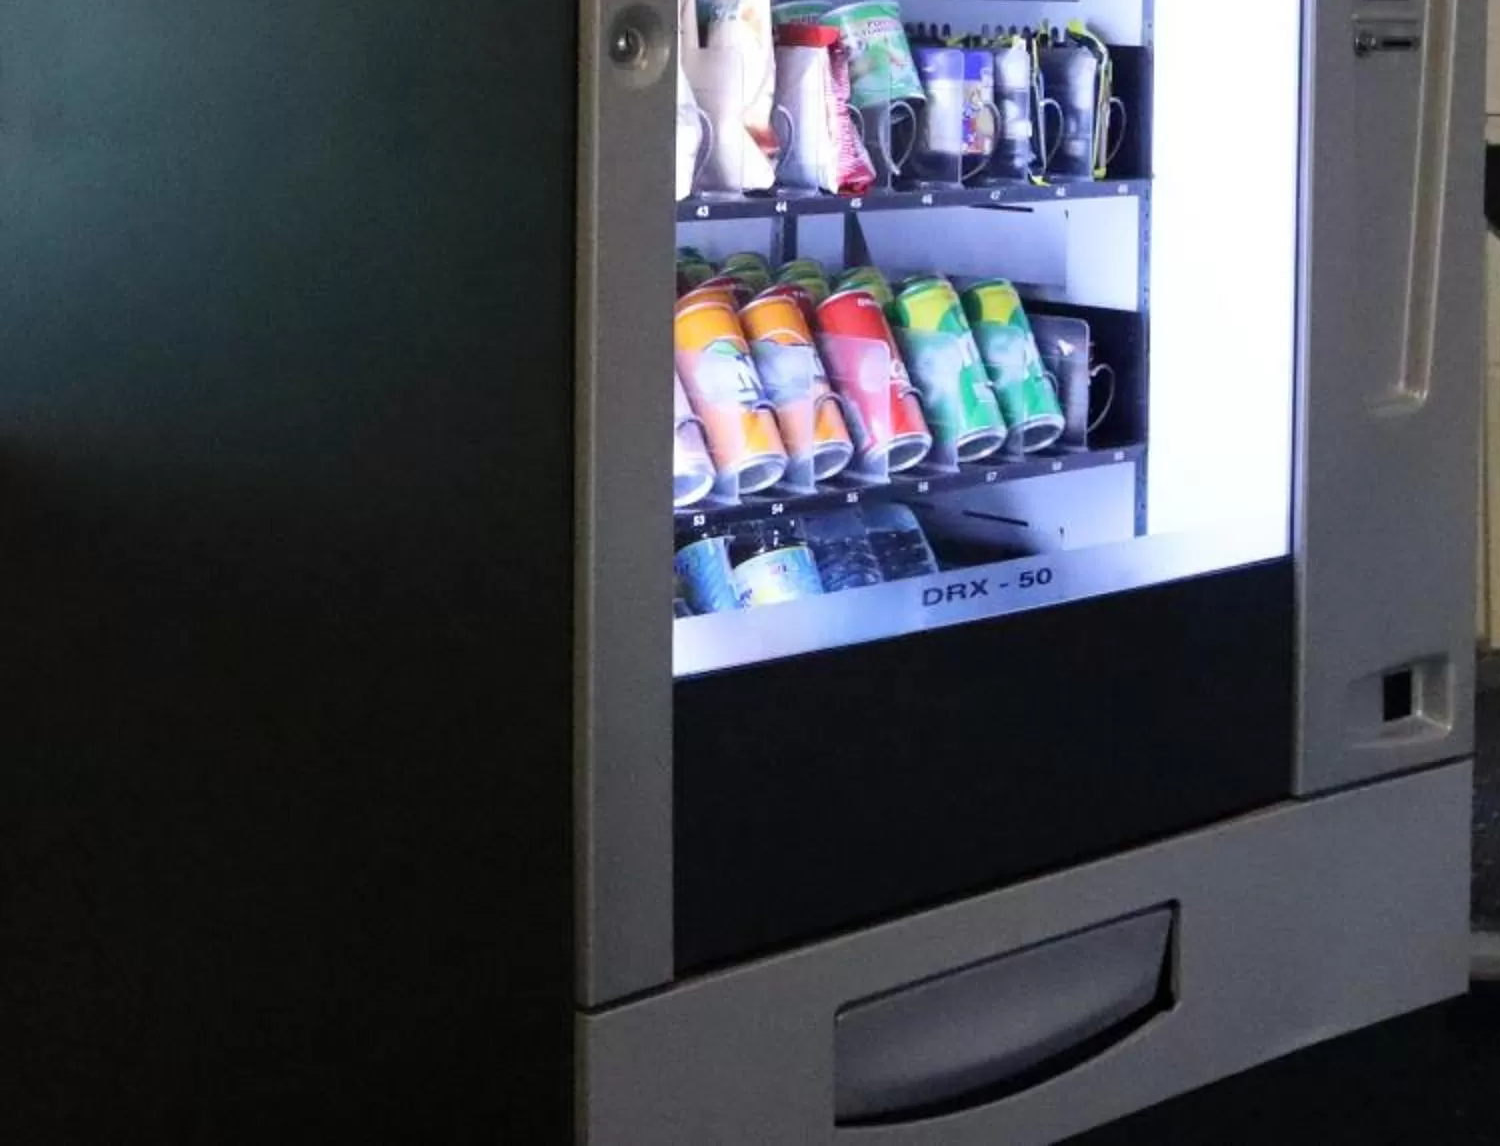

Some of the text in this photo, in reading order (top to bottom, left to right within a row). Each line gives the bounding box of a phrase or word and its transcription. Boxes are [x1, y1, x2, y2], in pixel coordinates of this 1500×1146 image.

[696, 205, 709, 217] 43
[775, 201, 787, 213] 44
[771, 503, 784, 515] 54
[693, 515, 705, 527] 53
[922, 578, 989, 607] DRX
[1018, 567, 1053, 588] 50
